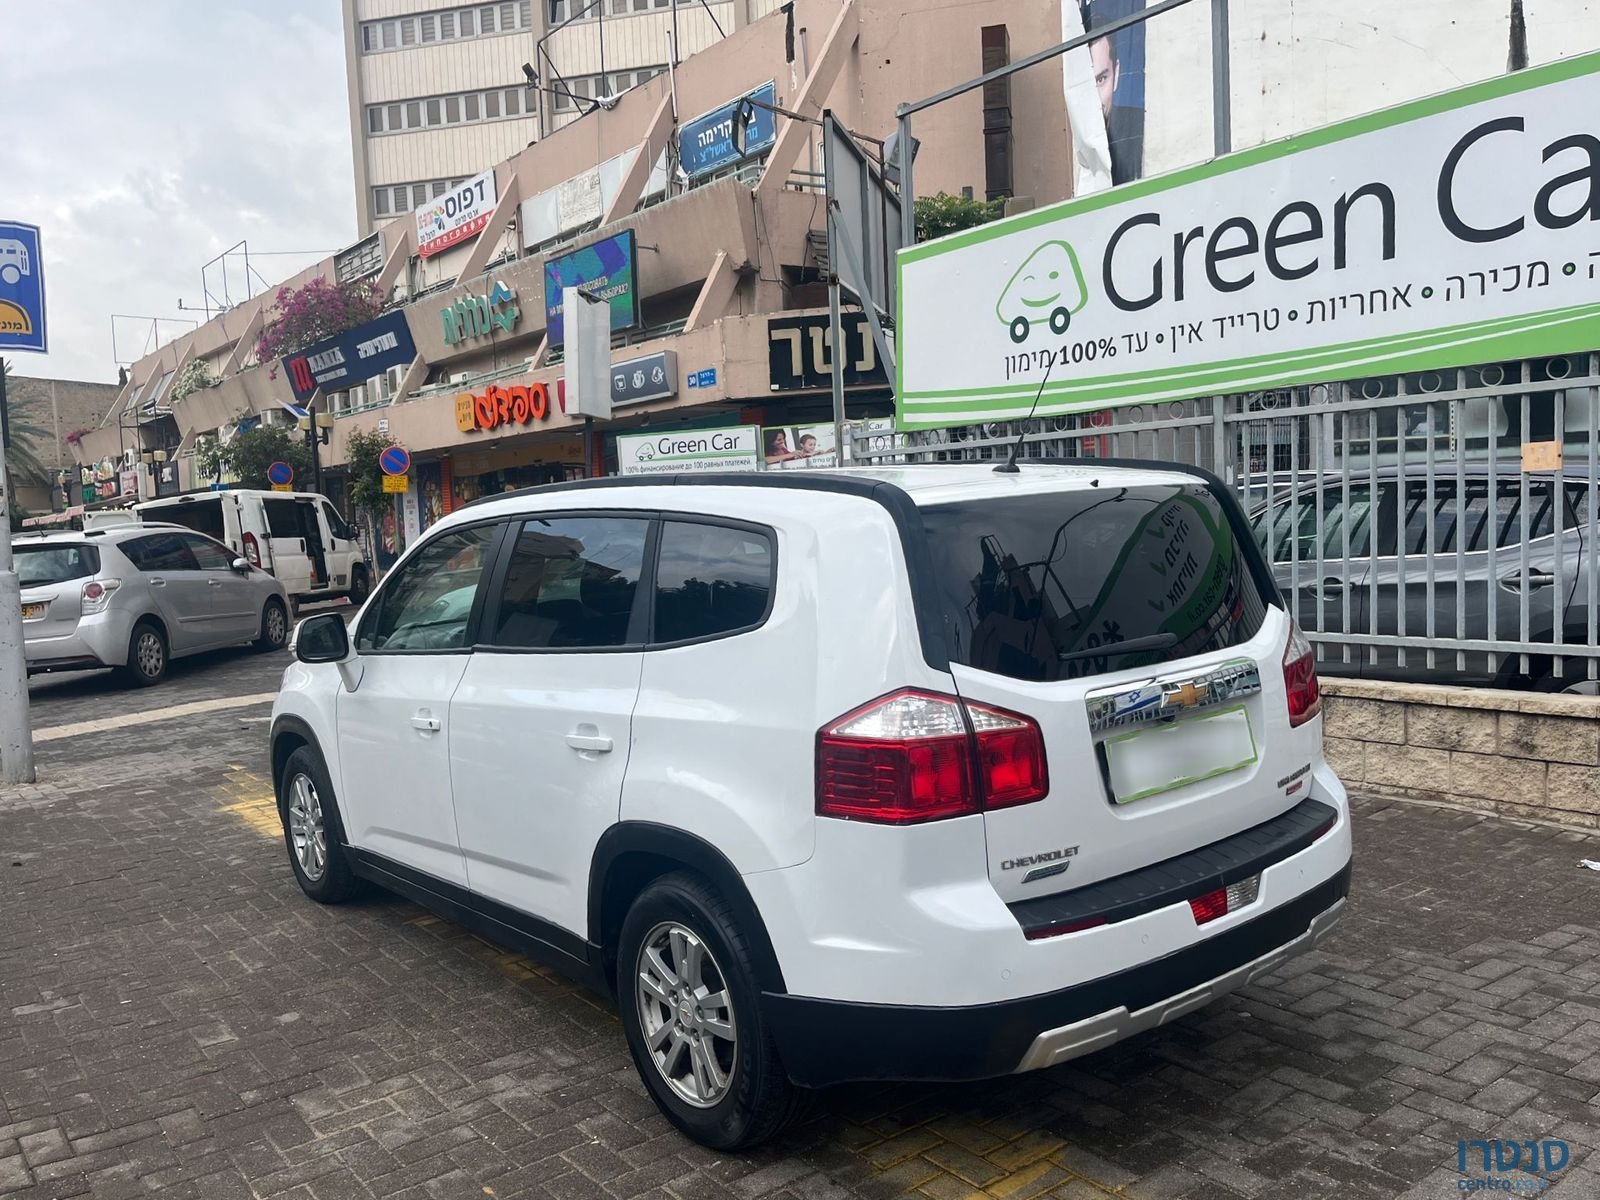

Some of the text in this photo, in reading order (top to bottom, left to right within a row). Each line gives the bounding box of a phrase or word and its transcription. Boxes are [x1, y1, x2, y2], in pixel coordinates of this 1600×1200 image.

[444, 179, 484, 218] דפוס
[1102, 182, 1396, 312] Green
[1004, 260, 1549, 381] מכירה אחריות טרייד אין עד 100% מימון
[688, 376, 696, 386] 30
[869, 422, 883, 430] Car
[658, 434, 740, 455] Green Car
[685, 462, 693, 470] до
[694, 460, 703, 470] 100
[1001, 844, 1081, 870] CHEVROLET
